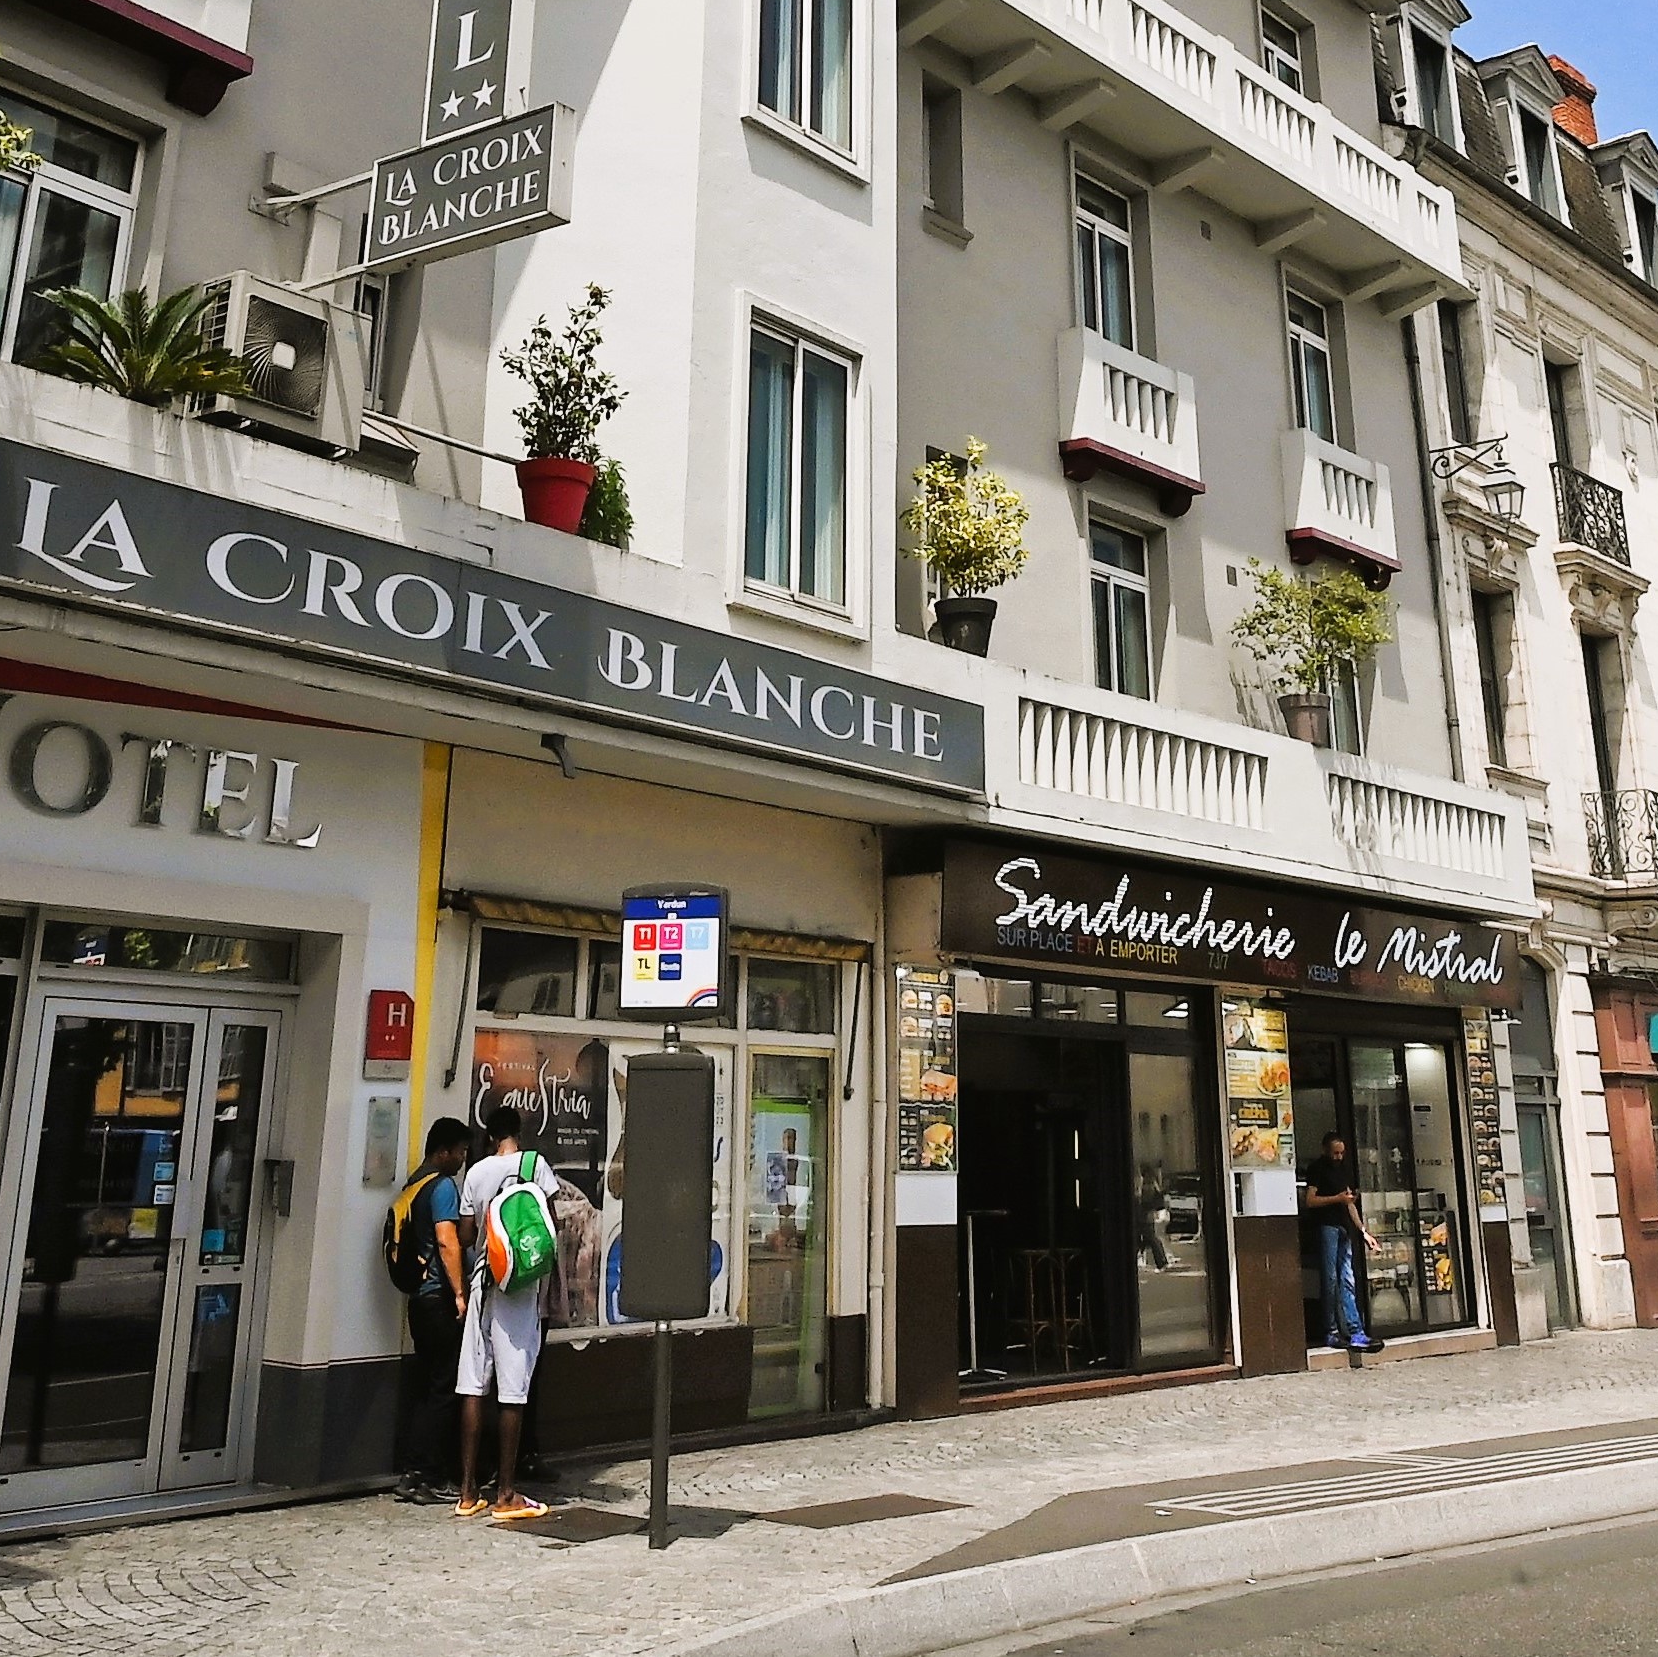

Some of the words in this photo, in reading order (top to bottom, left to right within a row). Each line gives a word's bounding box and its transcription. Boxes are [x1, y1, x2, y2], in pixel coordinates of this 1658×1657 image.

[386, 159, 419, 206] LA
[432, 124, 544, 186] CROIX
[377, 169, 541, 245] BLANCHE
[15, 475, 155, 593] LA
[204, 531, 556, 672] CROIX
[595, 626, 946, 764] BLANCHE
[639, 927, 652, 940] T1
[663, 926, 679, 940] T2
[690, 926, 704, 940] T7
[994, 857, 1296, 961] Sandwicherie
[1334, 911, 1367, 969] le
[1376, 925, 1504, 986] Mistral
[637, 958, 651, 970] TL
[996, 925, 1027, 947] SUR
[1029, 930, 1073, 953] PLACE
[1095, 937, 1105, 957] A
[1109, 939, 1179, 966] EMPORTER
[1306, 963, 1340, 984] KEBAB
[387, 1003, 407, 1028] H
